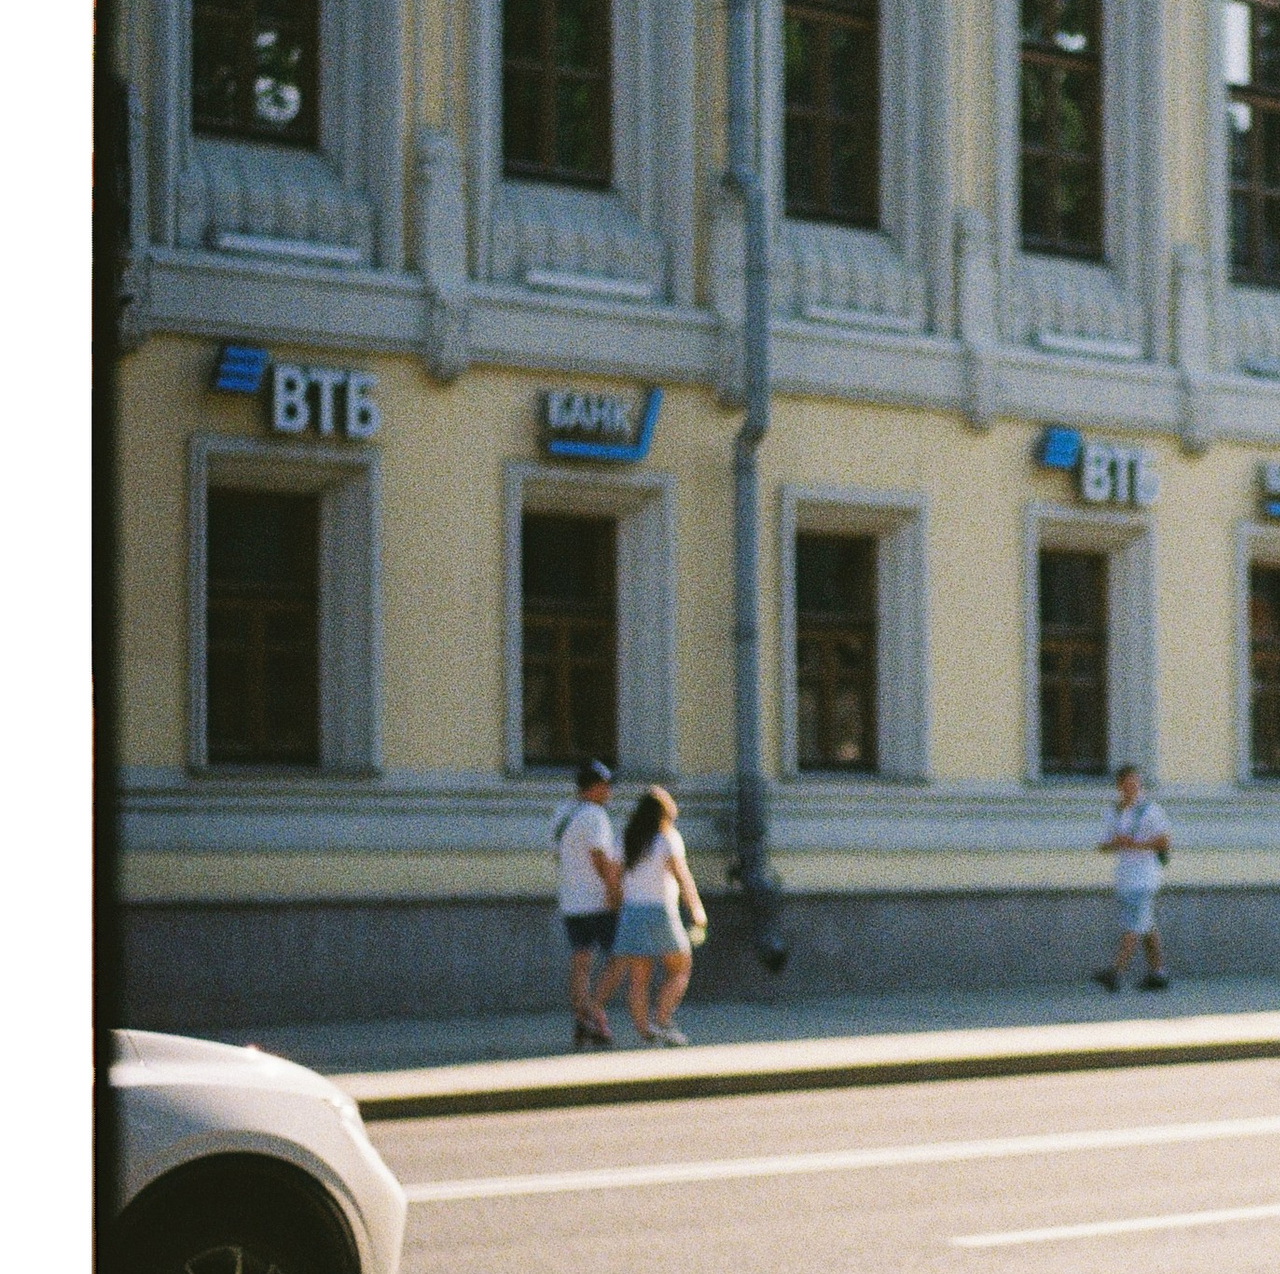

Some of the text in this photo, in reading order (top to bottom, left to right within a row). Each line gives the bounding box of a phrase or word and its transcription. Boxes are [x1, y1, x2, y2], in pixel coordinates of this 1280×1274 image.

[272, 364, 382, 439] ВТБ
[548, 391, 634, 434] БАНК
[1083, 442, 1162, 505] ВТБ
